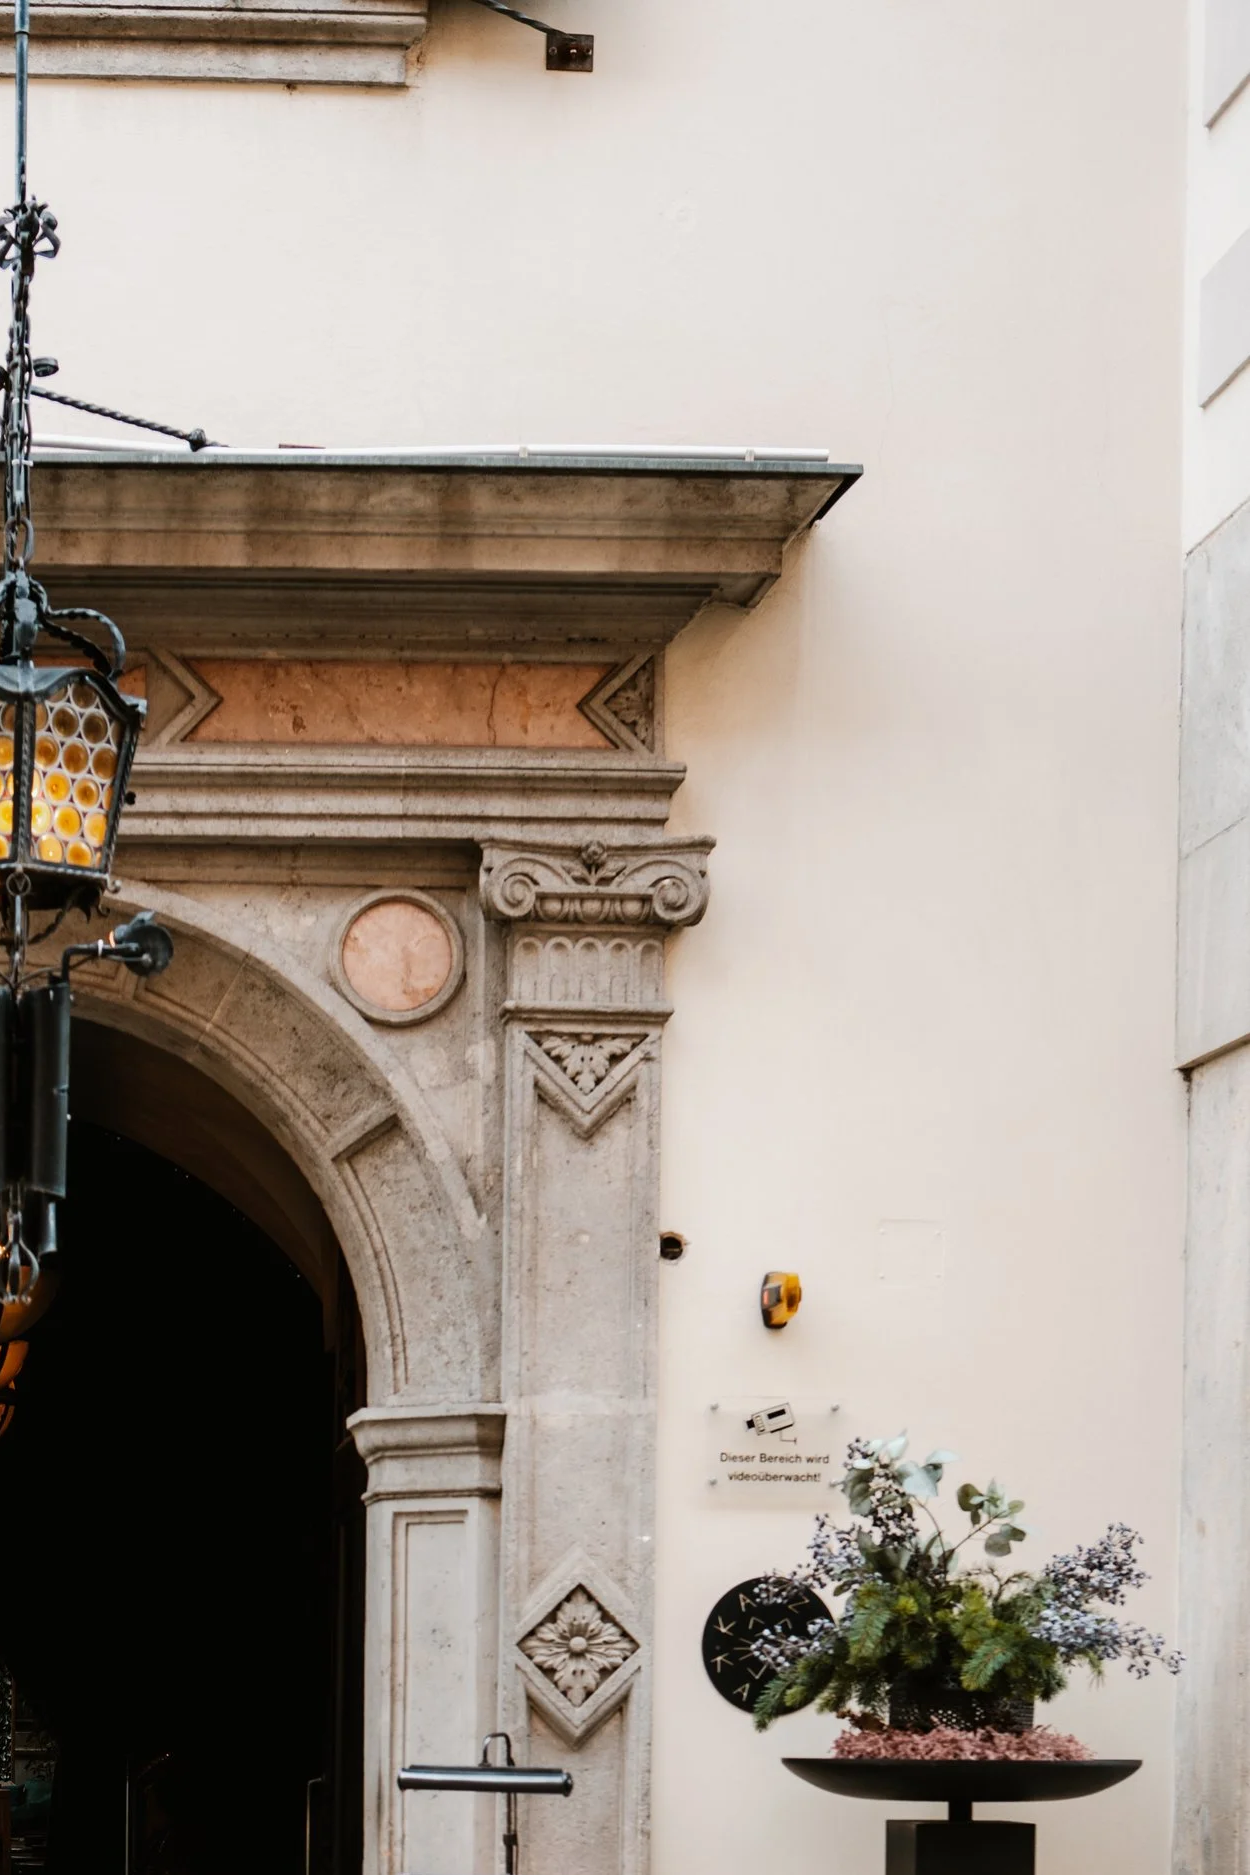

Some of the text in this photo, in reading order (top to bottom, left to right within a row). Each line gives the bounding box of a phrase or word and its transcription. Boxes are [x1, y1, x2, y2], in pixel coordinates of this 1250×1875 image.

[719, 1452, 830, 1464] Dieser Bereich wird
[728, 1471, 821, 1483] videoüberwacht!
